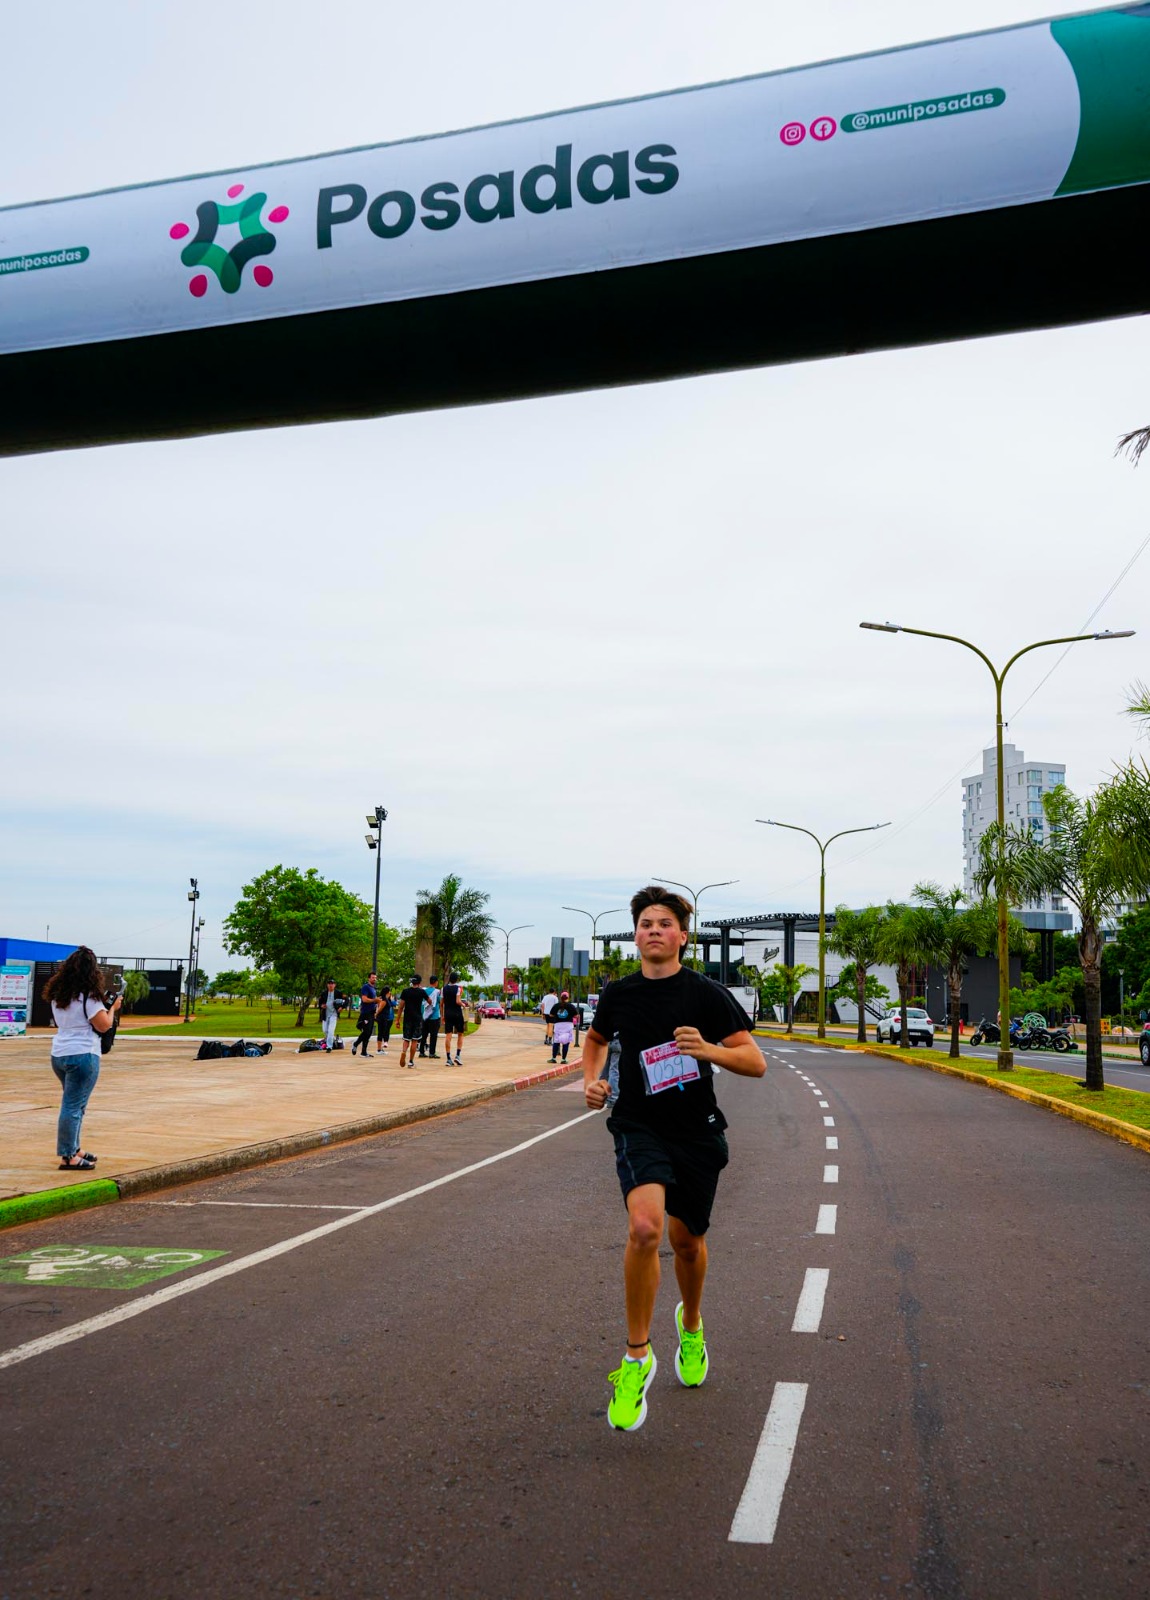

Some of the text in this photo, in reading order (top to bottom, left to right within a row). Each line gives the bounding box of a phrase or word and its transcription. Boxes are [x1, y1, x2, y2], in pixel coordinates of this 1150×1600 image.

[852, 92, 994, 131] @muniposadas
[316, 143, 680, 250] Posadas
[653, 1055, 684, 1083] 059
